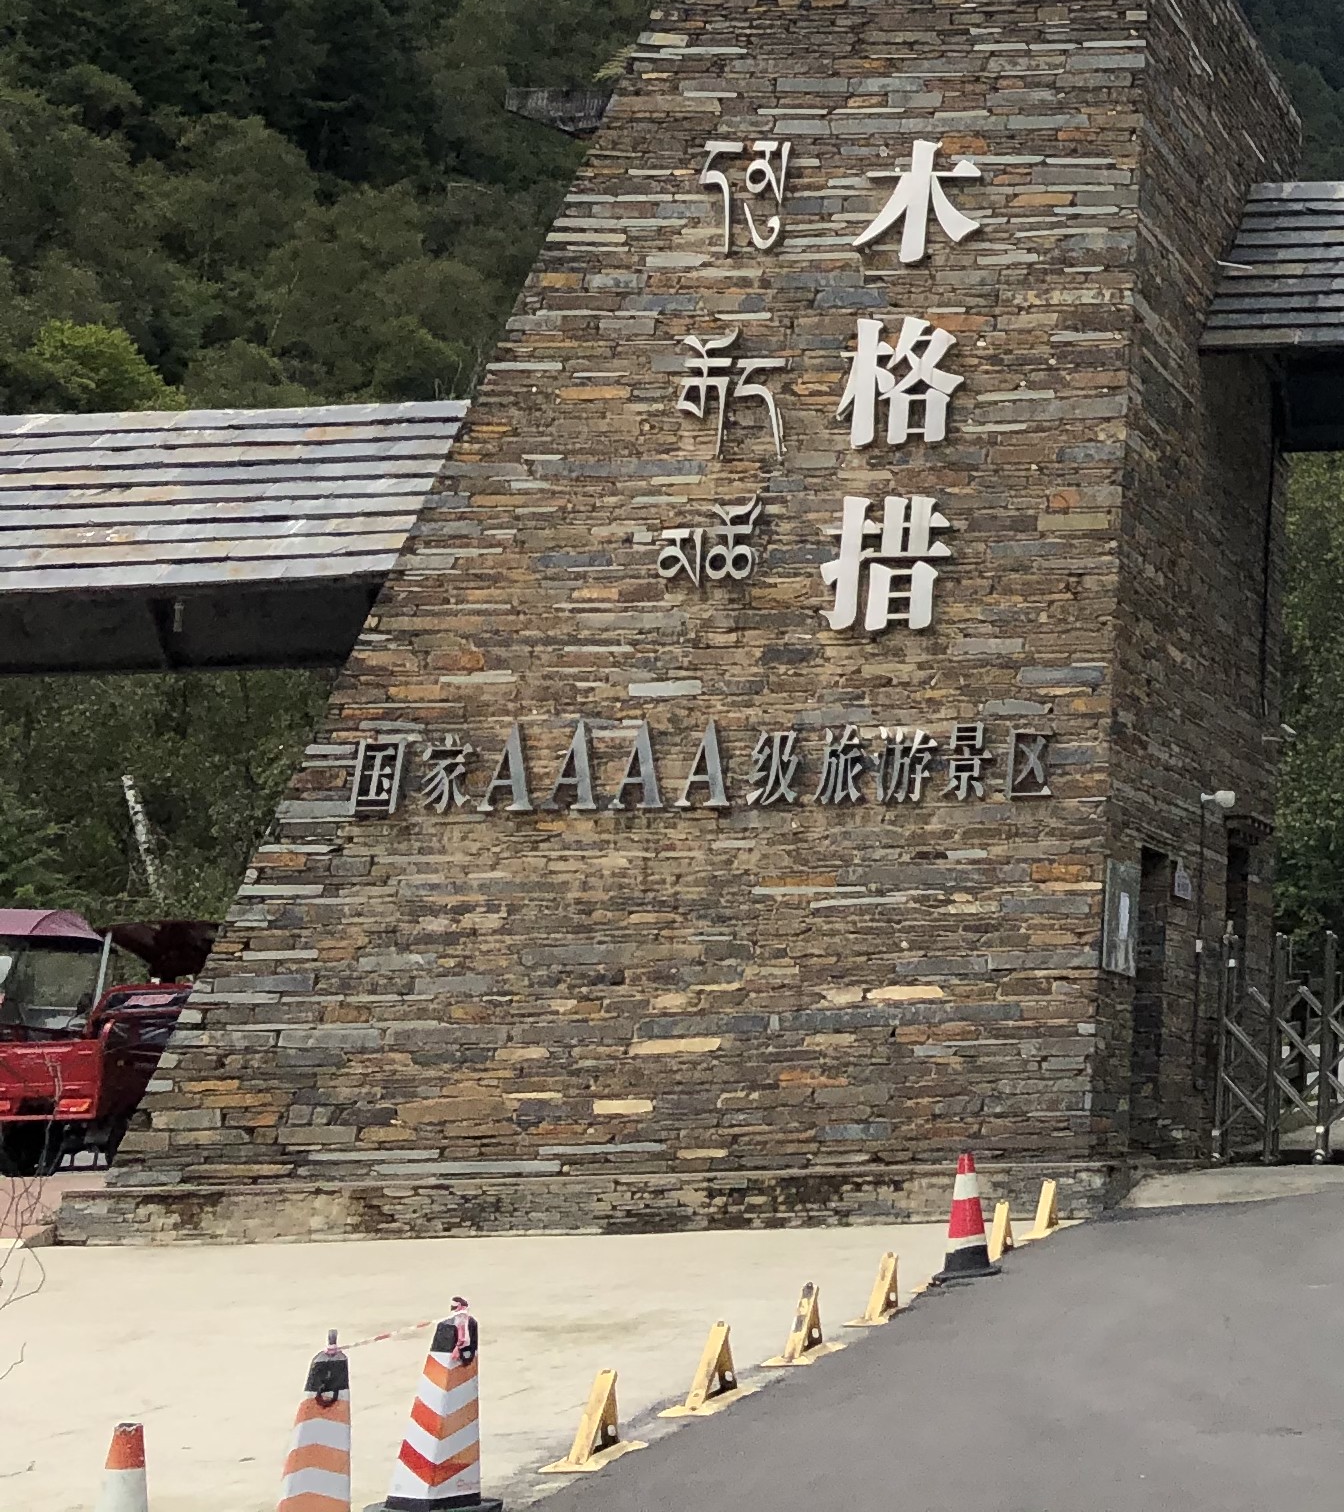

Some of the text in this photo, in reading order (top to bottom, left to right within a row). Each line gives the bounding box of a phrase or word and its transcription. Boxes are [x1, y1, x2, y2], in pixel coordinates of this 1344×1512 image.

[819, 138, 983, 632] 木格措
[352, 718, 1051, 815] 国家AAAA级旅游景区
